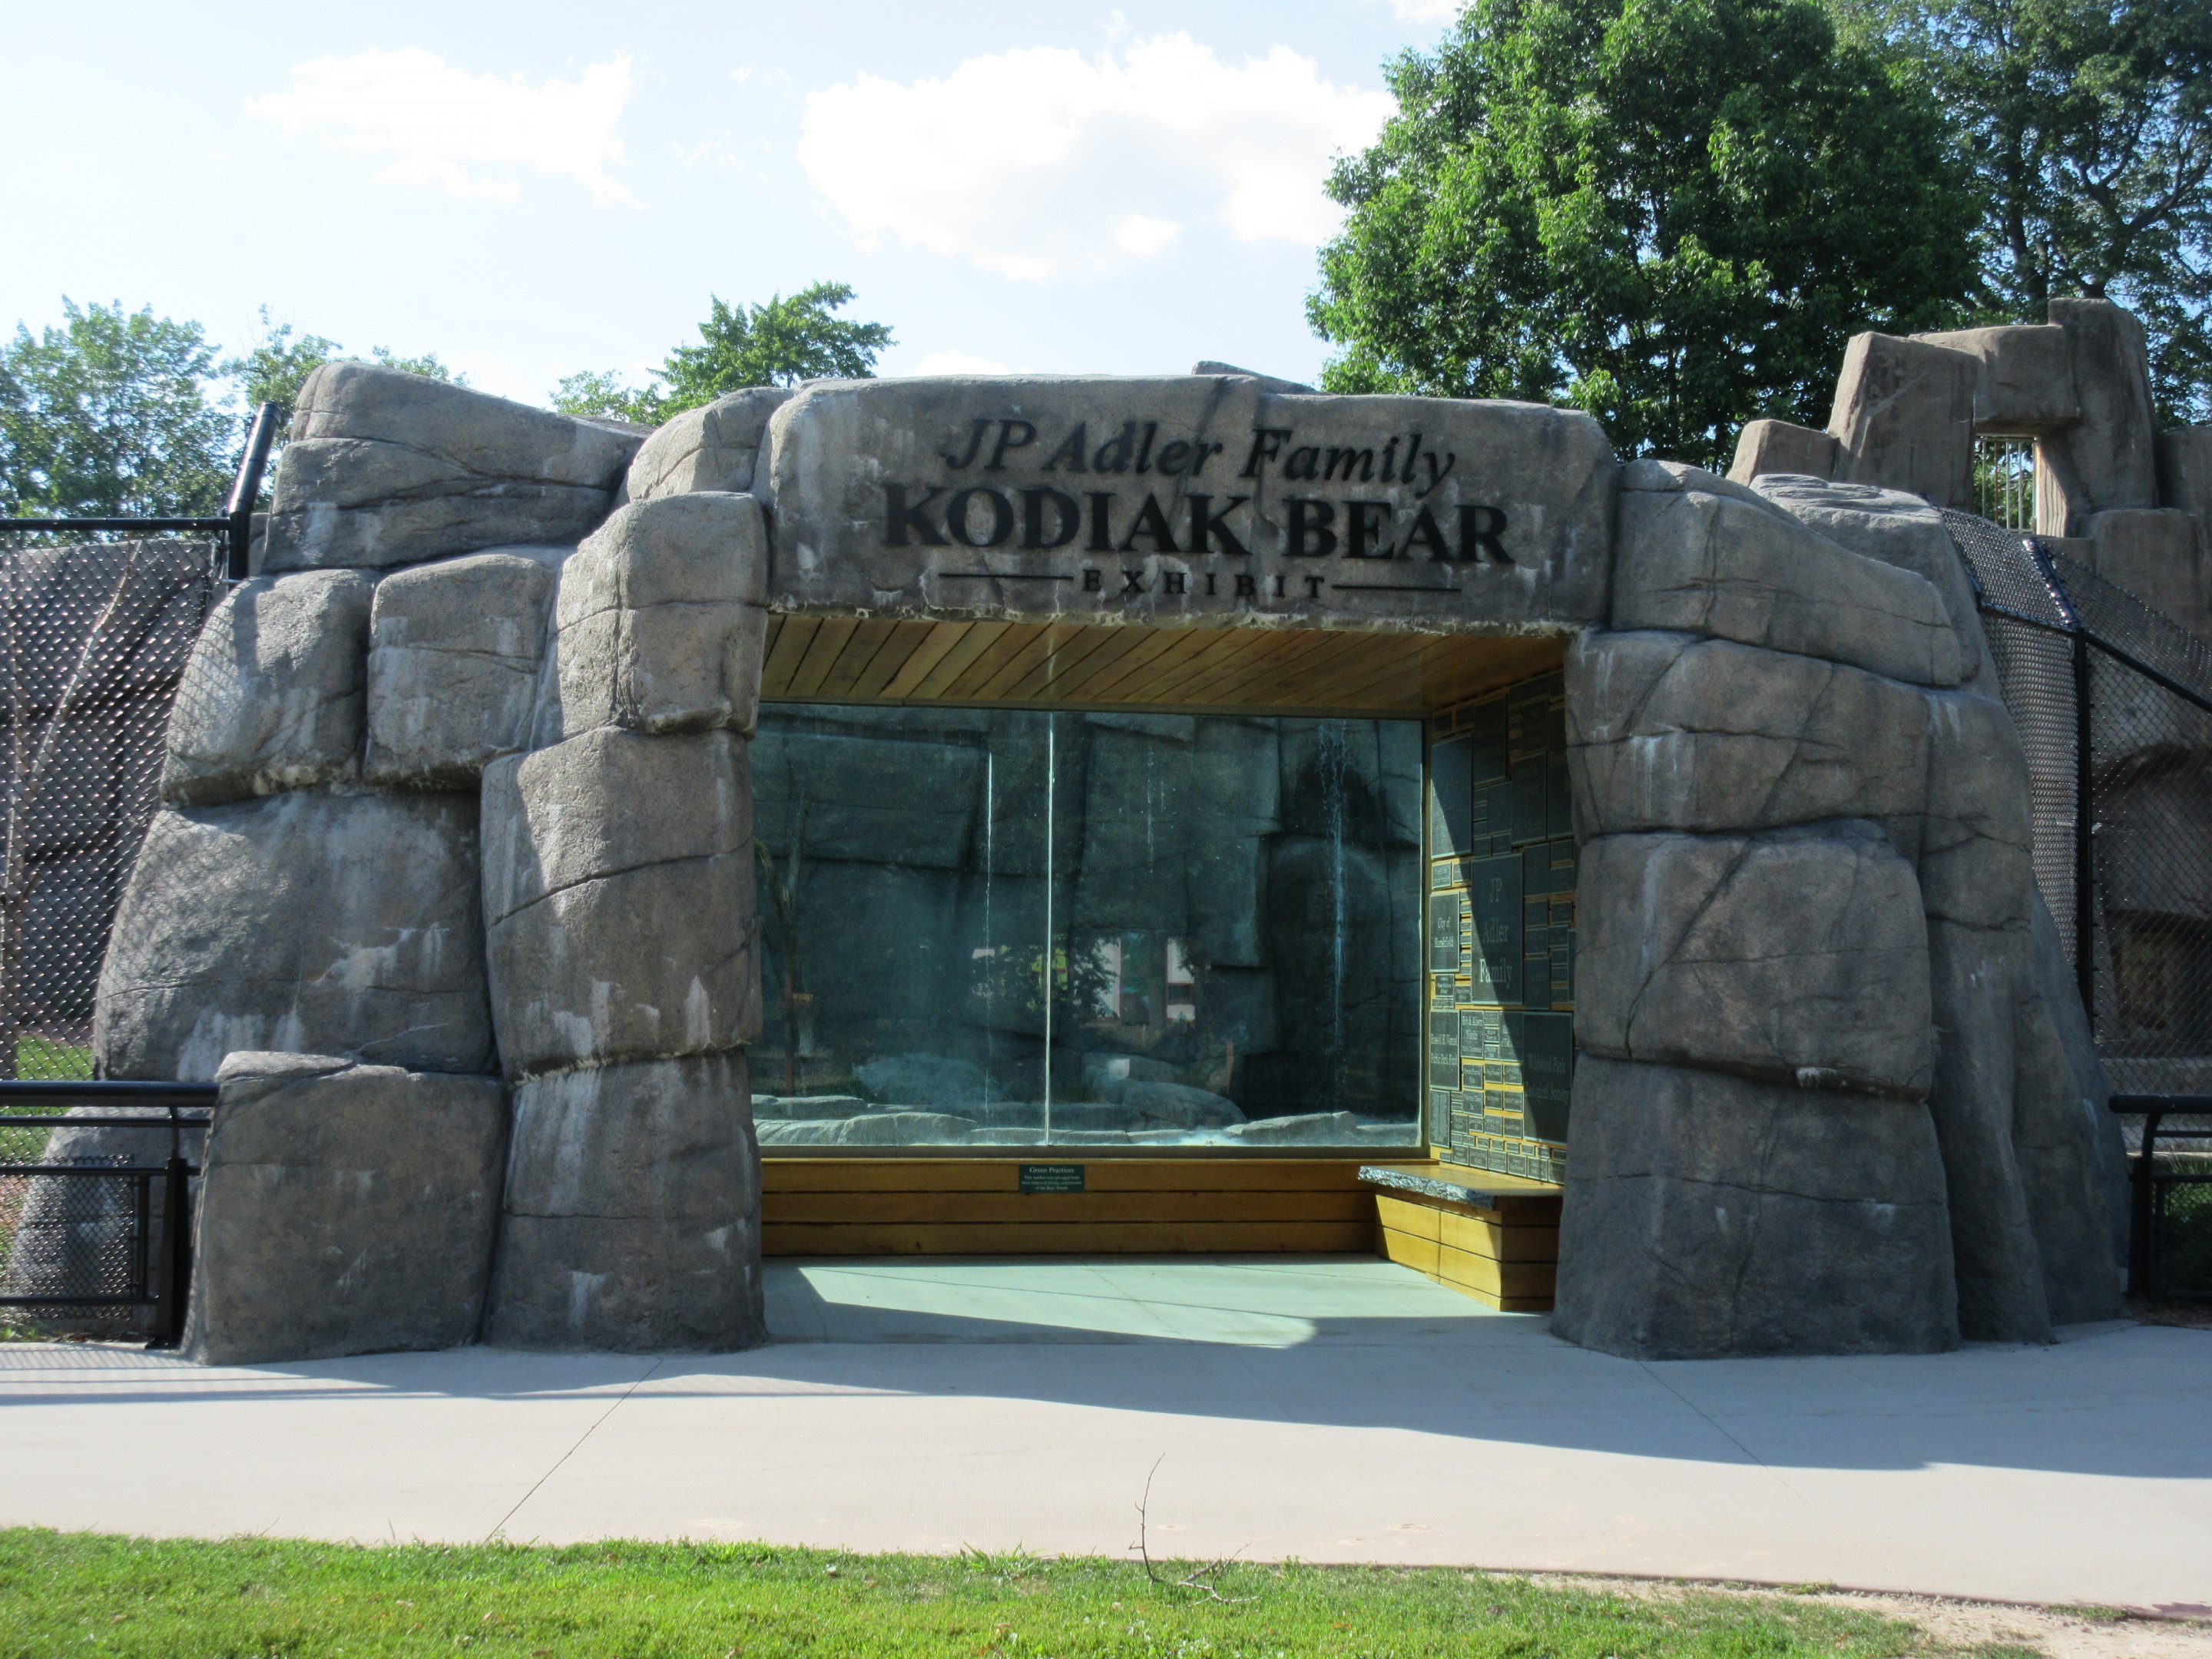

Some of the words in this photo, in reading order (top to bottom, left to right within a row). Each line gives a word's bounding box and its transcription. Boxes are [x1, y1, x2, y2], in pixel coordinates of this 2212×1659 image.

[938, 419, 1038, 472] JP
[1043, 421, 1223, 476] Adler
[1239, 428, 1456, 498] Family
[880, 484, 1253, 555] KODIAK
[1281, 498, 1516, 564] BEAR
[1081, 568, 1326, 599] EXHIBIT
[1488, 878, 1503, 904] JP
[1482, 918, 1510, 944] Adler
[1479, 958, 1514, 989] Family
